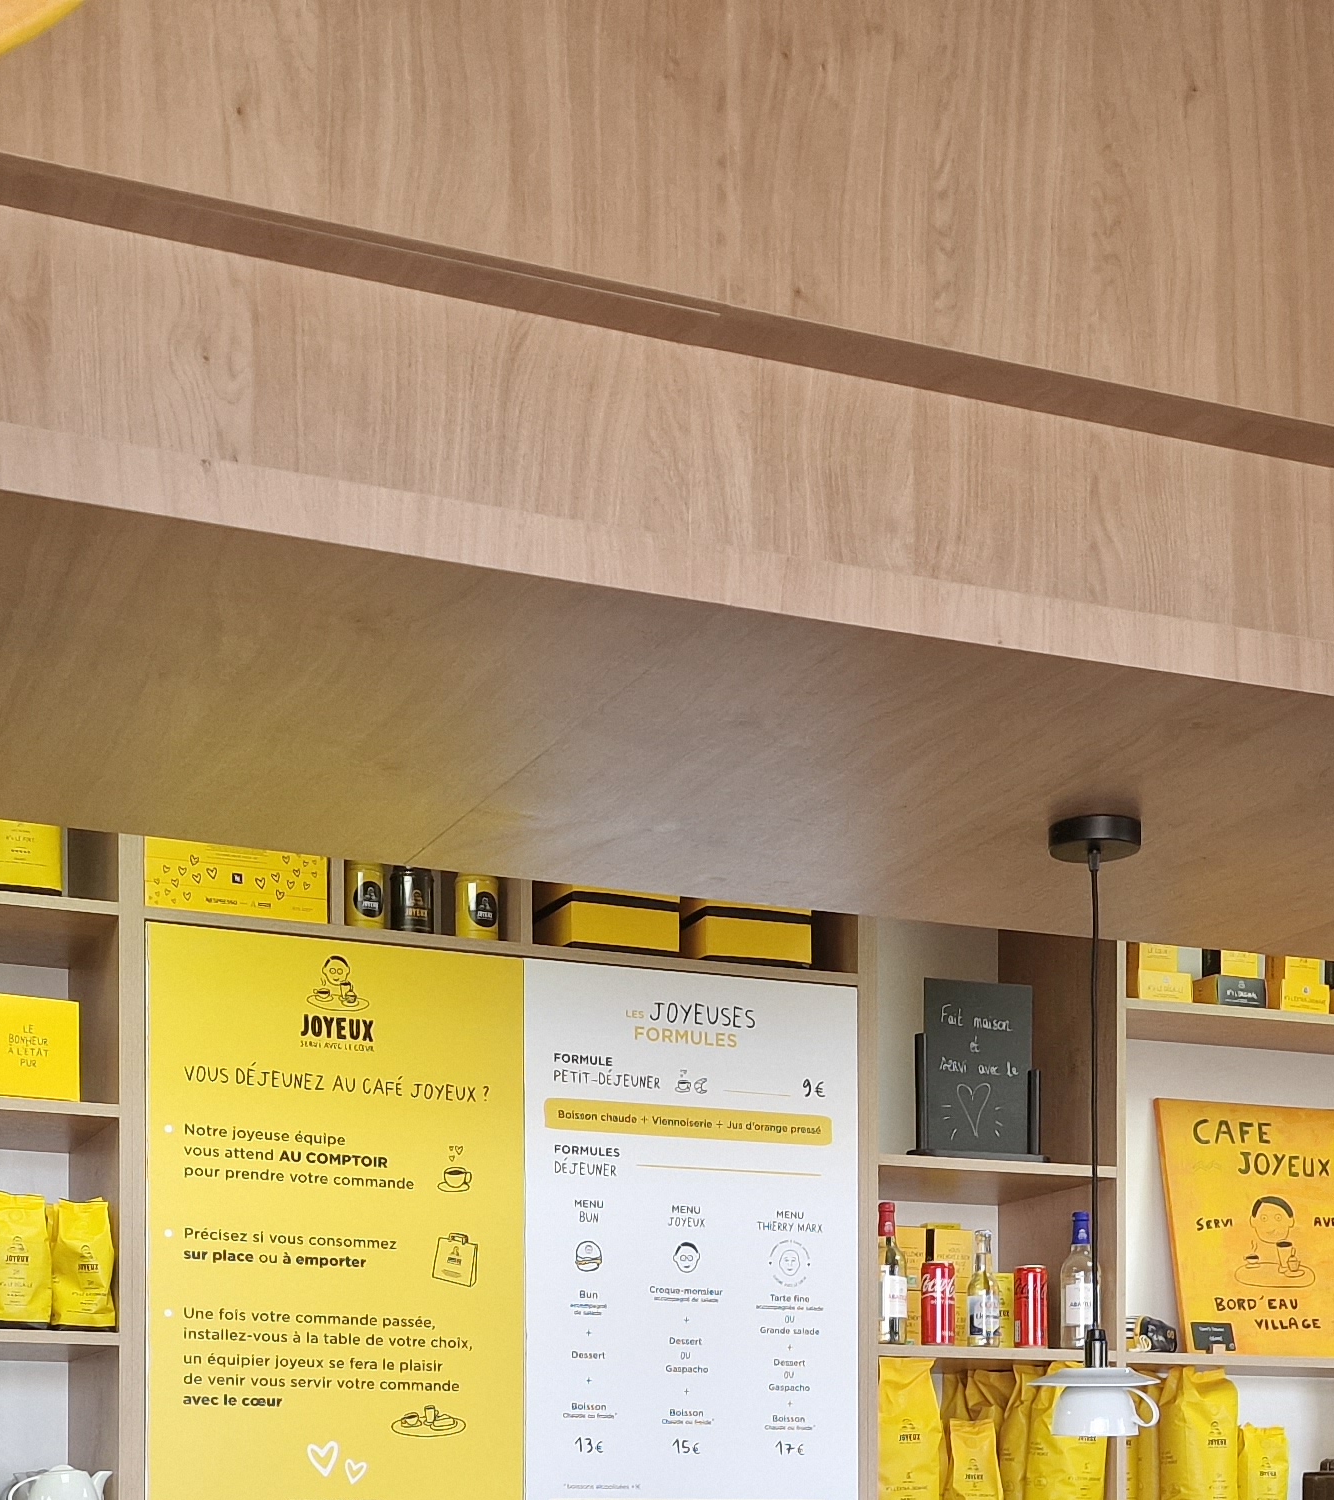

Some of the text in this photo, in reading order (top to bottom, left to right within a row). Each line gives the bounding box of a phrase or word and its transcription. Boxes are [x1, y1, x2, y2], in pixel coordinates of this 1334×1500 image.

[625, 1002, 755, 1028] LES JOYEUSES
[941, 1002, 1013, 1031] Fait maison
[301, 1014, 373, 1042] JOYEUX
[635, 1026, 737, 1048] FORMULES
[554, 1053, 613, 1066] FORMULE
[977, 1065, 1000, 1075] avec
[1006, 1061, 1019, 1077] le
[184, 1066, 229, 1083] VOUS
[236, 1062, 324, 1090] DÉJEUNEZ
[332, 1075, 355, 1092] AU
[363, 1076, 403, 1096] CAFÉ
[411, 1083, 476, 1102] JOYEUX
[802, 1079, 825, 1098] 9€
[558, 1110, 821, 1134] Boisson chaude Viennoiserie Jus d'orange pressé
[185, 1123, 345, 1147] Notre joyeuse équipe
[1193, 1119, 1272, 1144] CAFE
[184, 1146, 388, 1168] vous attend AU COMPTOIR
[554, 1144, 620, 1157] FORMULES
[554, 1157, 616, 1177] DÉJEUNER
[1238, 1152, 1330, 1177] JOYEUX
[184, 1167, 414, 1190] pour prendre votre commande
[574, 1199, 604, 1209] MENU
[672, 1205, 701, 1214] MENU
[579, 1211, 599, 1223] BUN
[668, 1217, 705, 1228] JOYEUX
[776, 1210, 804, 1220] MENU
[797, 1223, 822, 1233] MARX
[1196, 1217, 1233, 1231] SERVI
[185, 1227, 397, 1250] Précisez si vous consommez
[184, 1249, 366, 1268] sur place ou à emporter
[579, 1290, 598, 1299] Bun
[1214, 1295, 1298, 1311] BORD'EAU
[184, 1307, 435, 1330] Une fois votre commande passée,
[1254, 1317, 1321, 1330] VILLAGE
[760, 1326, 790, 1334] Grande
[184, 1327, 472, 1351] installez-vous à la table de votre choix,
[184, 1353, 443, 1373] un équipier joyeux se fera le plaisir
[571, 1351, 605, 1359] Dessert
[665, 1365, 709, 1374] Gaspacho
[183, 1373, 459, 1392] de venir vous servir votre commande
[183, 1396, 219, 1405] avec
[224, 1394, 237, 1406] le
[571, 1402, 606, 1411] Boisson
[575, 1437, 603, 1453] 13€
[672, 1439, 700, 1454] 15€
[775, 1440, 804, 1456] 17€
